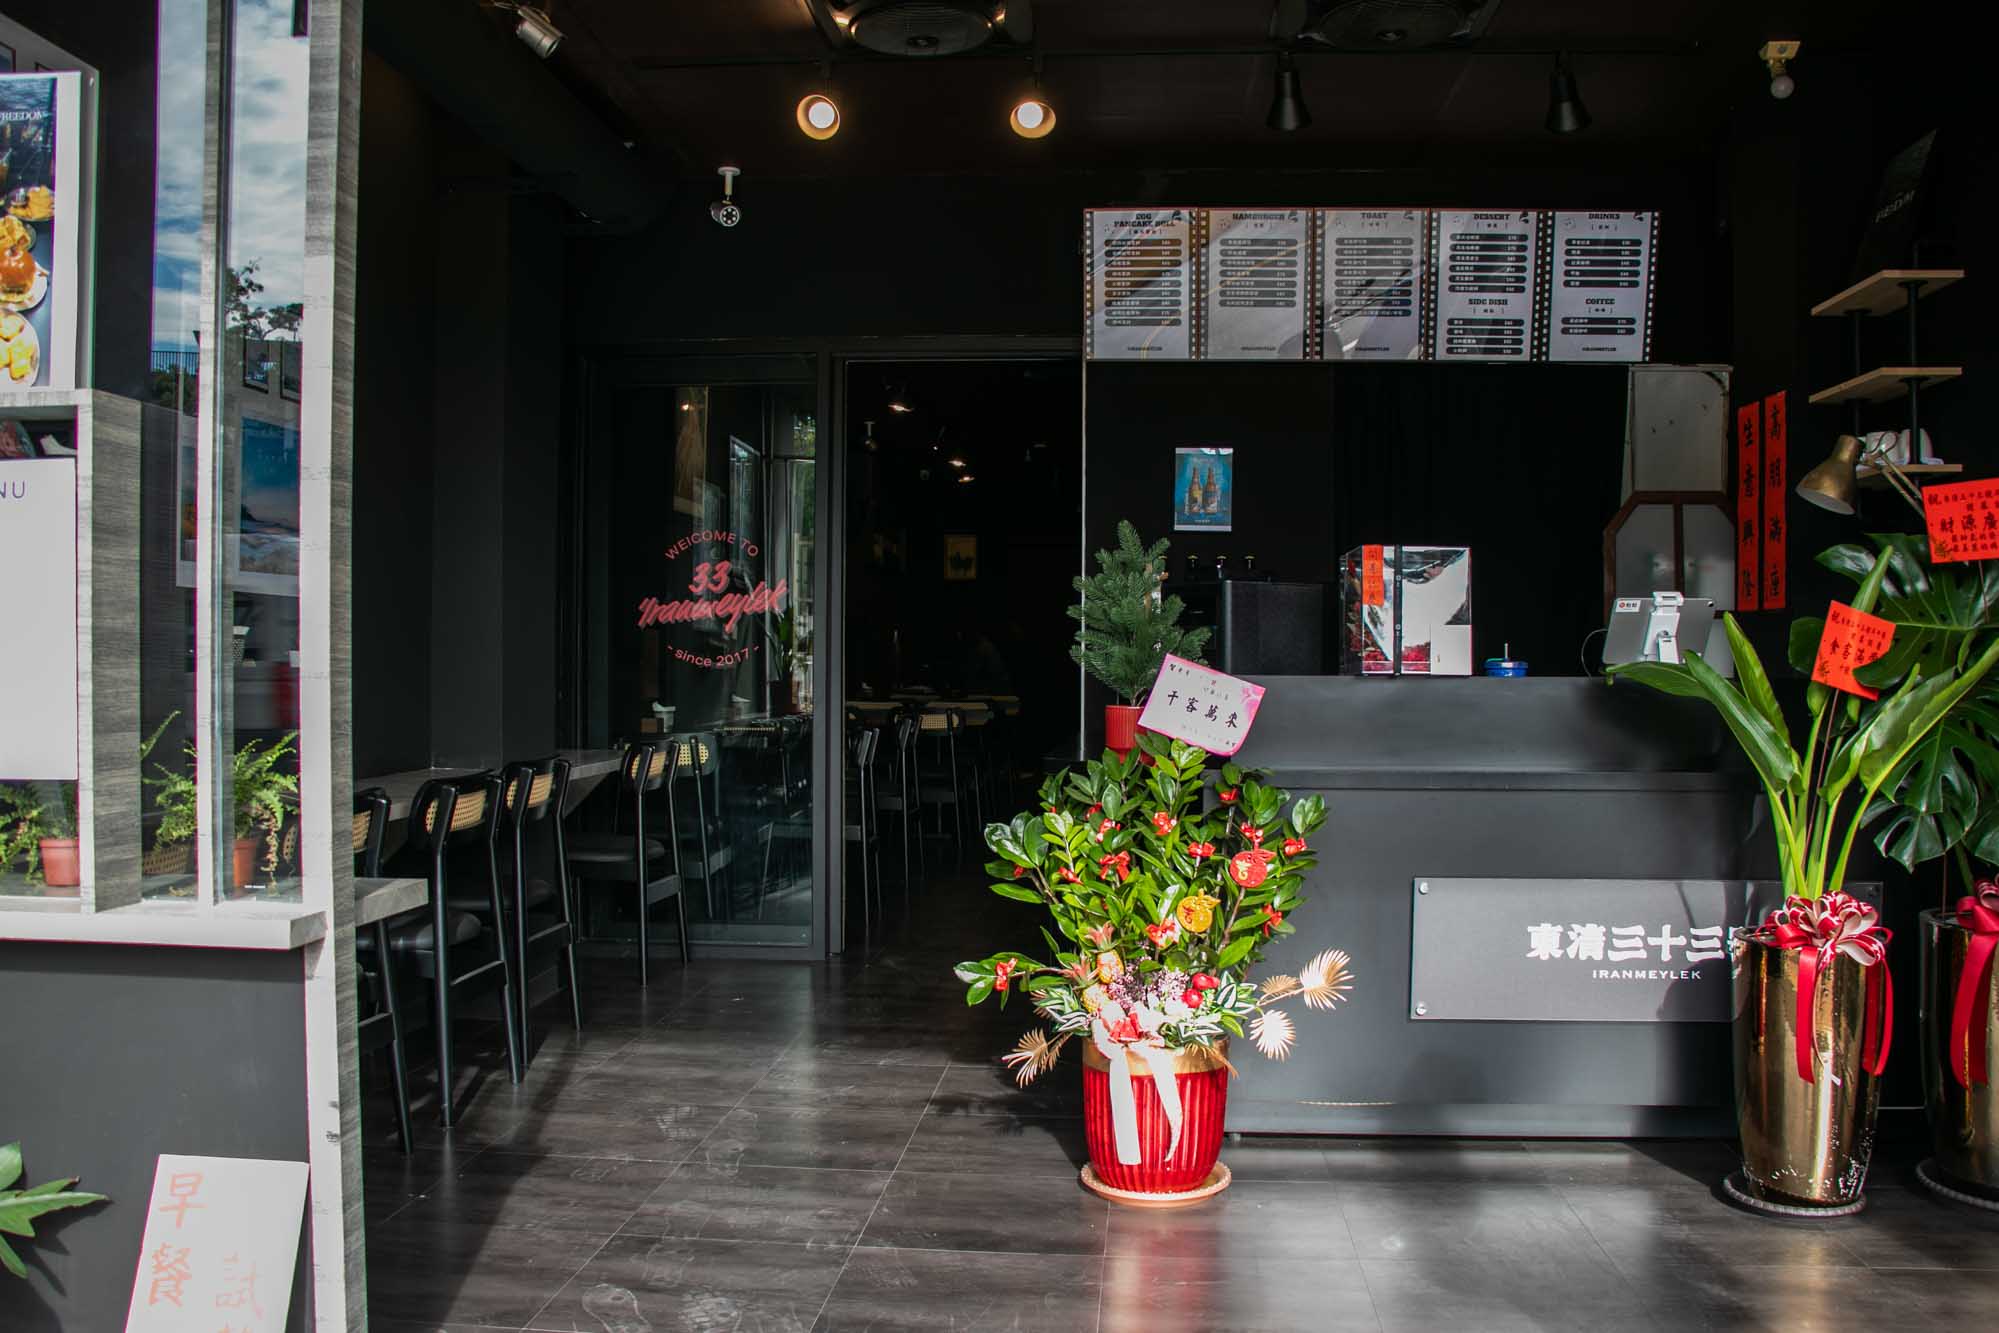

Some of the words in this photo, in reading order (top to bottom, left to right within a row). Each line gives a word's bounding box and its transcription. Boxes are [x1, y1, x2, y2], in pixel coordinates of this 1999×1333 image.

[1588, 212, 1620, 220] DRINKS
[664, 529, 737, 560] WELCOME
[740, 537, 759, 557] TO
[688, 560, 732, 594] 33
[674, 648, 712, 667] since
[716, 647, 750, 667] 2017
[1592, 969, 1702, 981] IRANMEYLEK
[148, 1171, 209, 1308] 早餐
